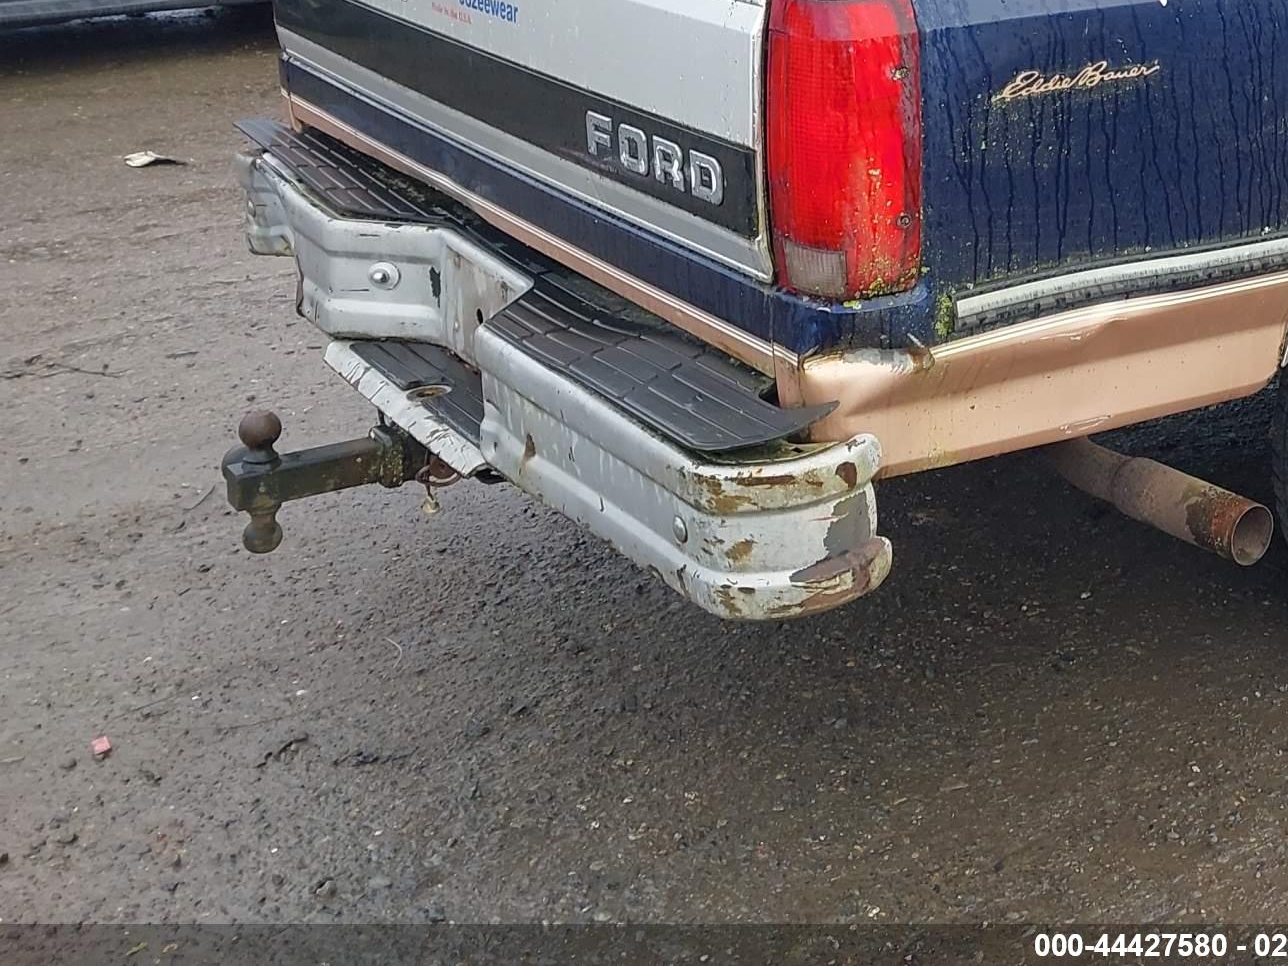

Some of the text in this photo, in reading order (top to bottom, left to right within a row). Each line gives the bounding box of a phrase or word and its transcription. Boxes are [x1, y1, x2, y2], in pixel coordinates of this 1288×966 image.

[991, 59, 1160, 102] Eddie Bauer
[584, 109, 725, 206] FORD
